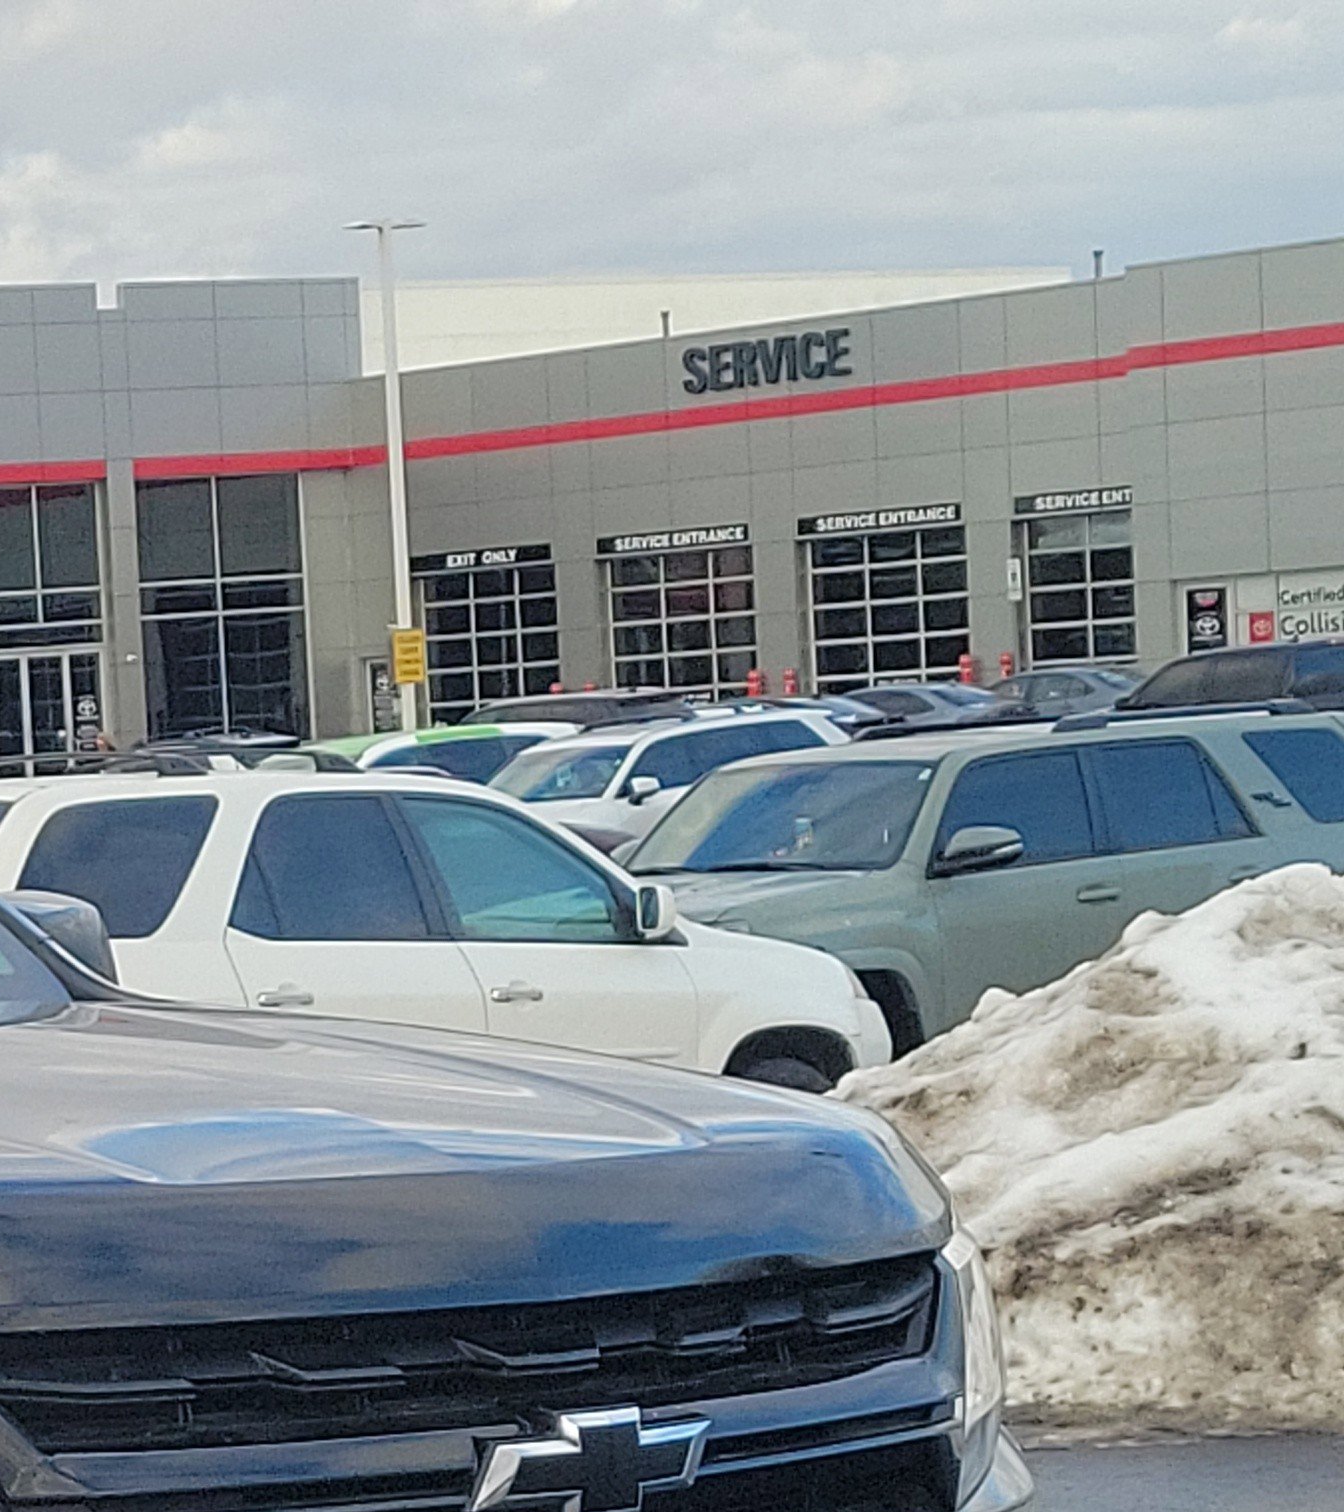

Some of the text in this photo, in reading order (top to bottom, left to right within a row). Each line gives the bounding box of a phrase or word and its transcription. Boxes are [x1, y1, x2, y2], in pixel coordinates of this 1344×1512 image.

[682, 328, 852, 394] SERVICE
[1035, 491, 1100, 511] SERVICE
[816, 504, 956, 532] SERVICE ENTRANCE
[614, 526, 745, 552] SERVICE ENTRANCE
[446, 548, 517, 568] EXIT ONLY
